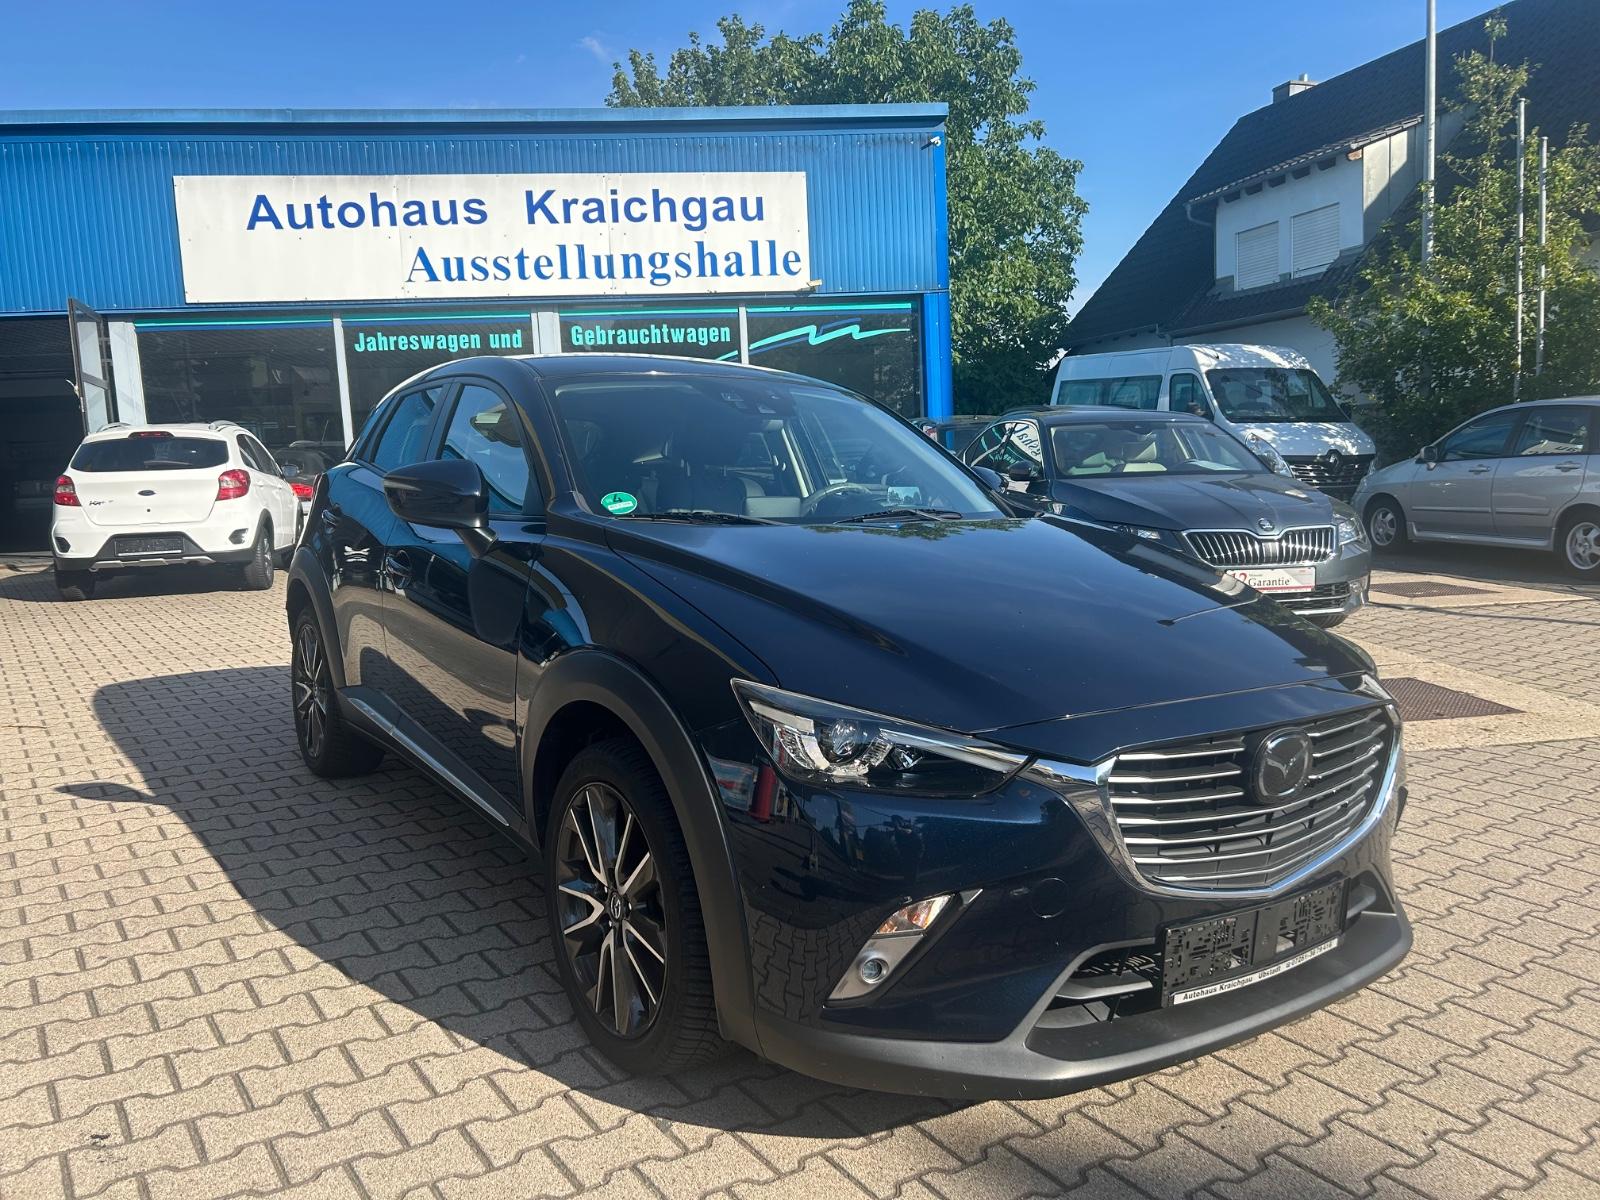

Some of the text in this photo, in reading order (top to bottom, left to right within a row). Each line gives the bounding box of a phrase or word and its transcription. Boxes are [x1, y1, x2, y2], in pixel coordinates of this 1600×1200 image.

[247, 189, 764, 232] Autohaus Kraichgau
[407, 239, 802, 286] Ausstellungshalle
[354, 324, 731, 353] Jahreswagen und Gebrauchtwagen
[1248, 576, 1290, 587] Garantie
[1182, 987, 1217, 1001] Autohaus
[1218, 976, 1253, 991] Kraichgau
